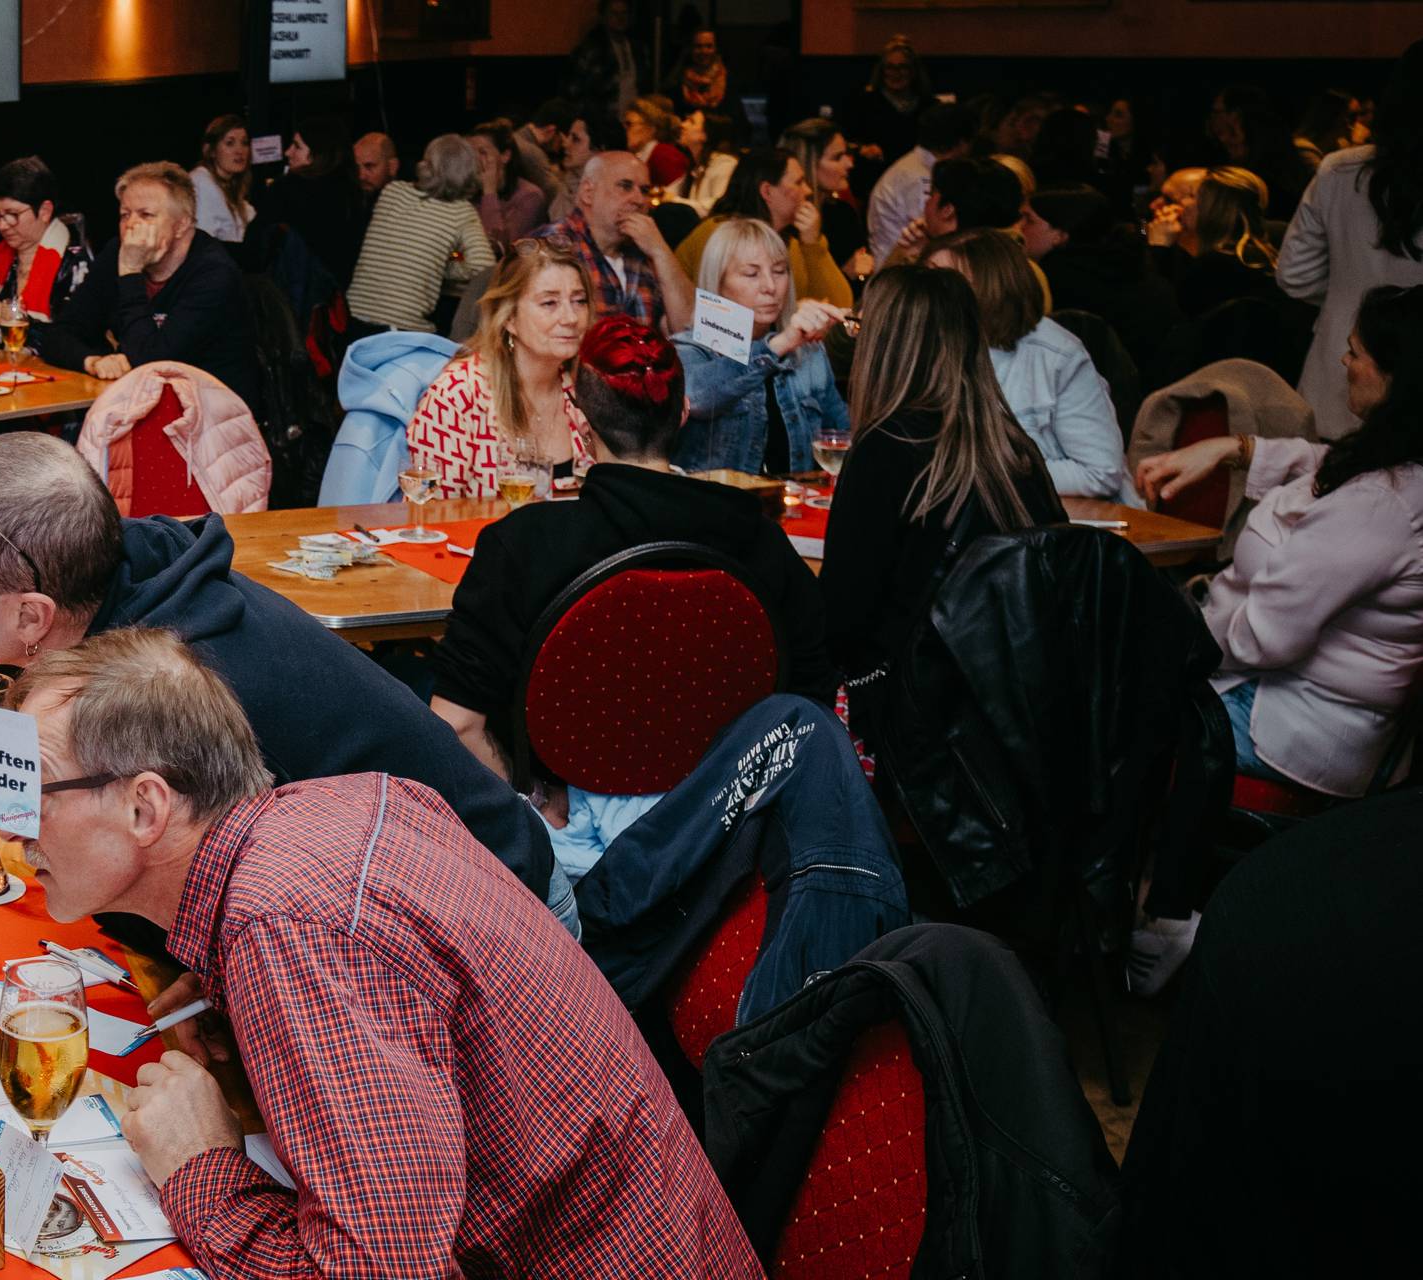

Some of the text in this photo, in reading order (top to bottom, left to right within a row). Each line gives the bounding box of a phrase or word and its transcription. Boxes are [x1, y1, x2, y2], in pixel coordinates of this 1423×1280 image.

[796, 722, 815, 736] EVEN
[737, 722, 791, 772] CAMP DAVID
